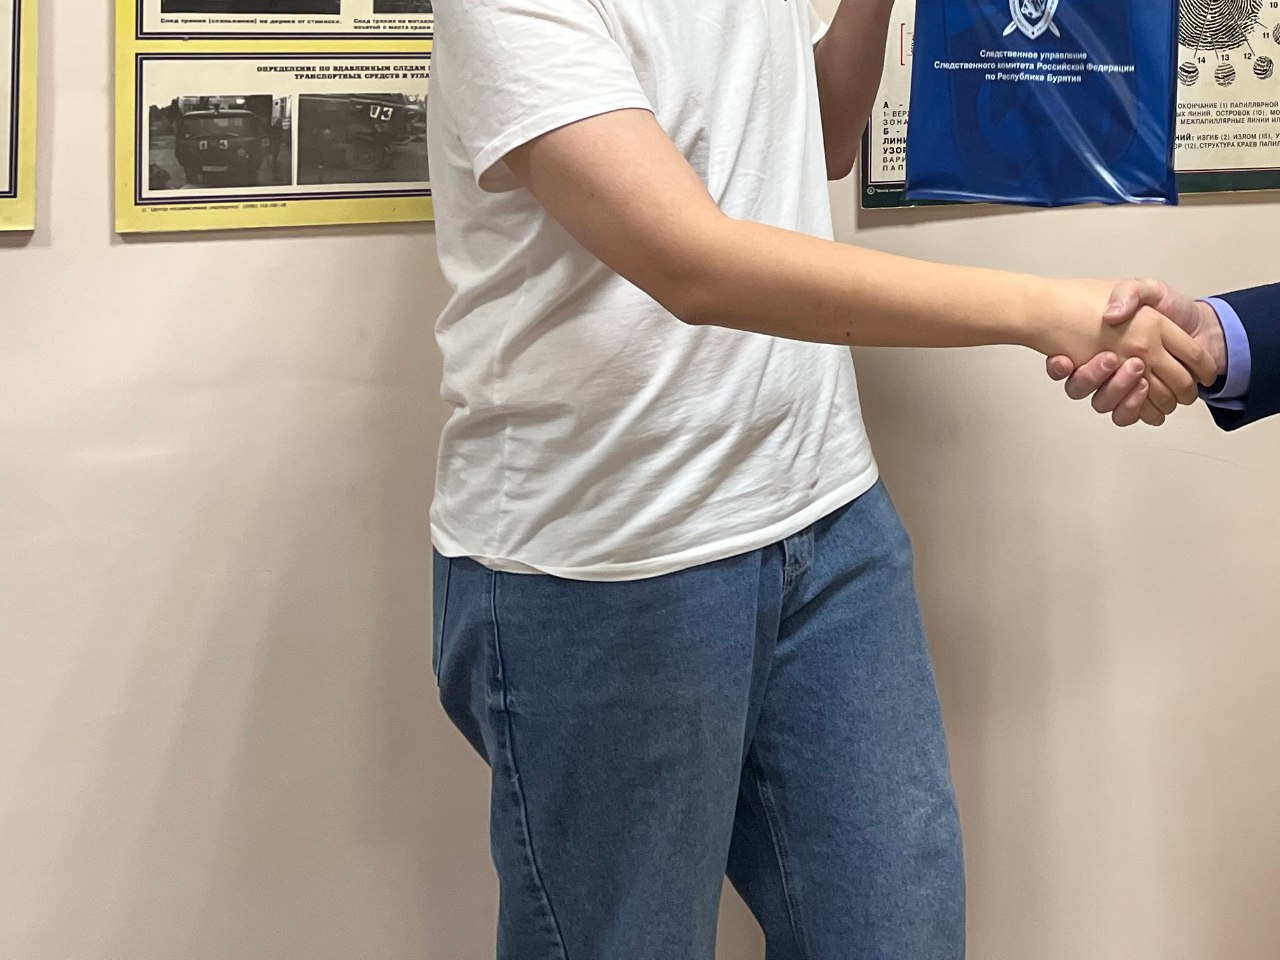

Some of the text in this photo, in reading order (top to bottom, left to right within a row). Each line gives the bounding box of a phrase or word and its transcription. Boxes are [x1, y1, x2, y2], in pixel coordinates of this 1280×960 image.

[979, 49, 1087, 60] Следственное управление
[934, 60, 995, 69] Следственного
[1036, 62, 1084, 70] Российской
[1086, 63, 1134, 72] Федерации
[997, 72, 1044, 81] Республике
[1046, 73, 1081, 83] Бурятия
